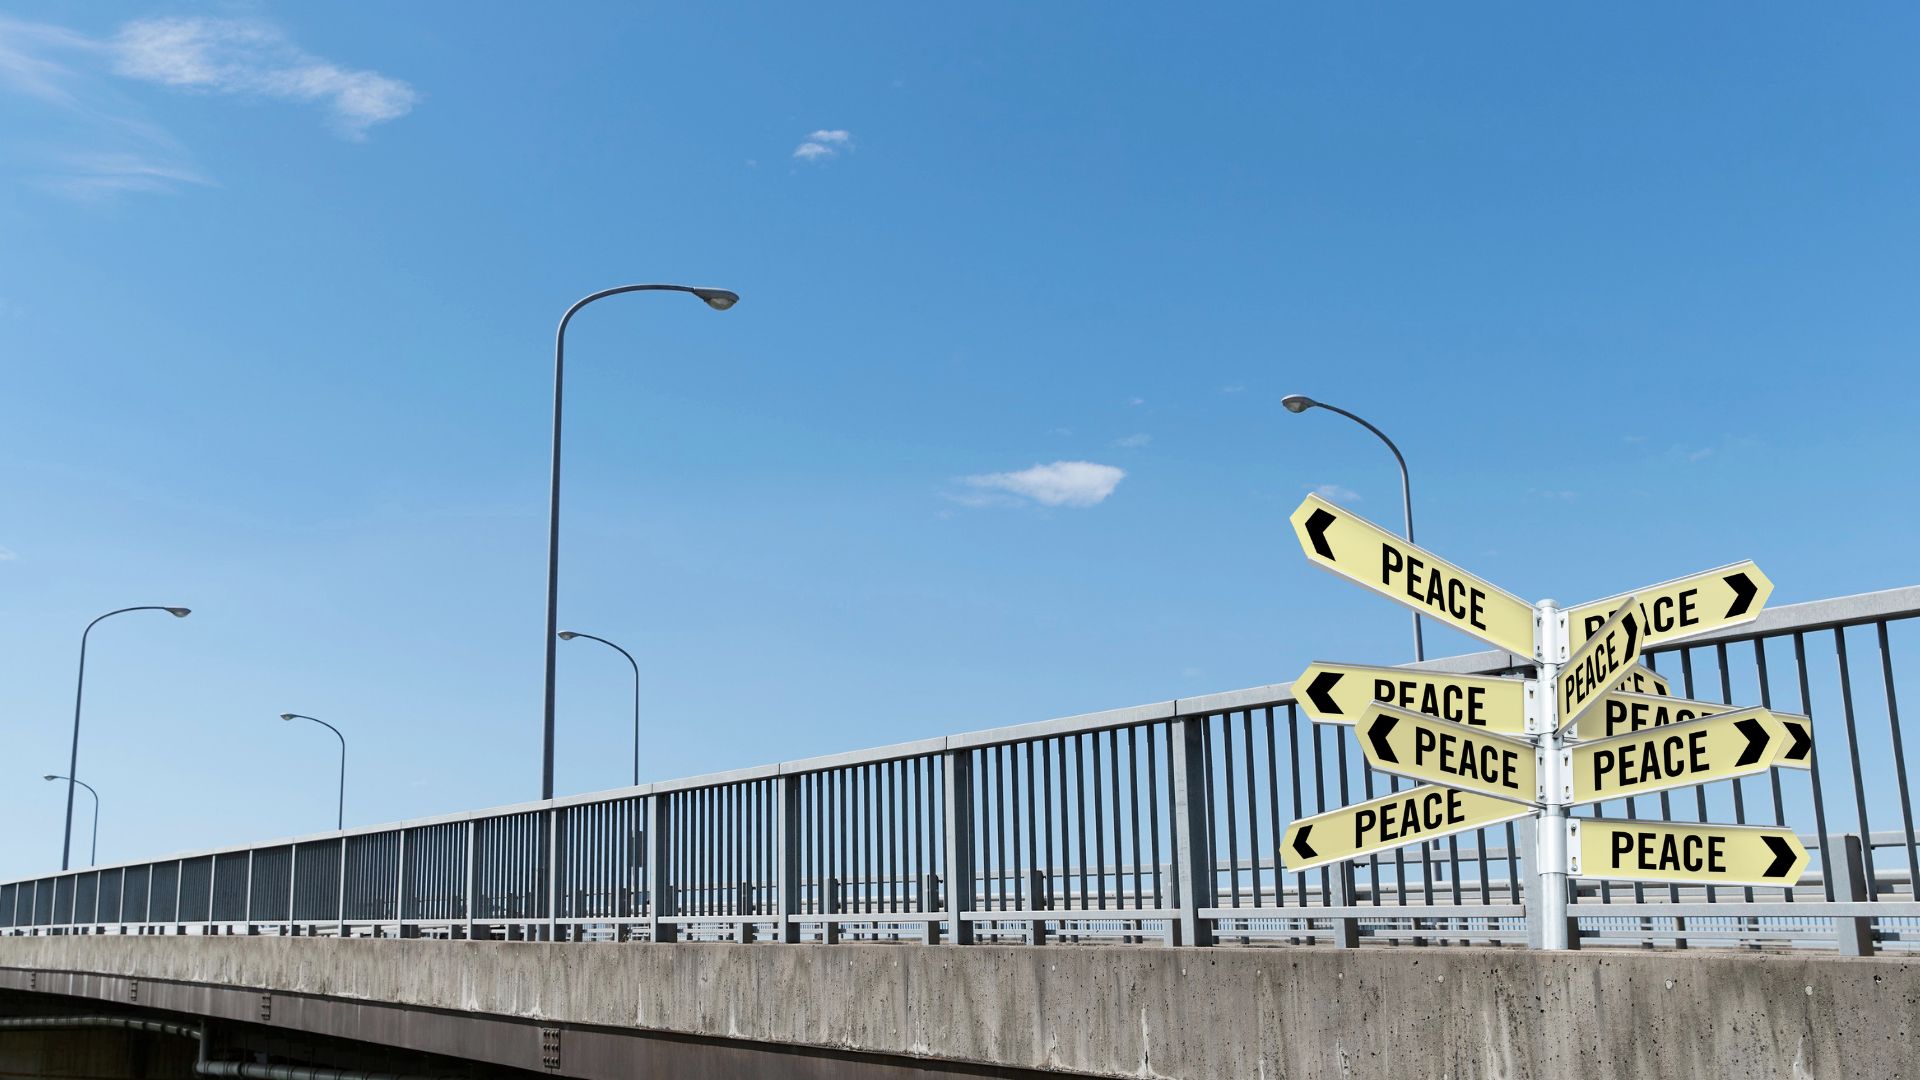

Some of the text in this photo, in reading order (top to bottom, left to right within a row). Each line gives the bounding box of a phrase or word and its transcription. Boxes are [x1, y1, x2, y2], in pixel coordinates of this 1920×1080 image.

[1383, 543, 1486, 631] PEACE
[1565, 630, 1620, 714] PEACE
[1415, 726, 1519, 789] PEACE
[1594, 730, 1710, 791] PEACE
[1355, 789, 1465, 849] PEACE
[1612, 831, 1726, 873] PEACE
